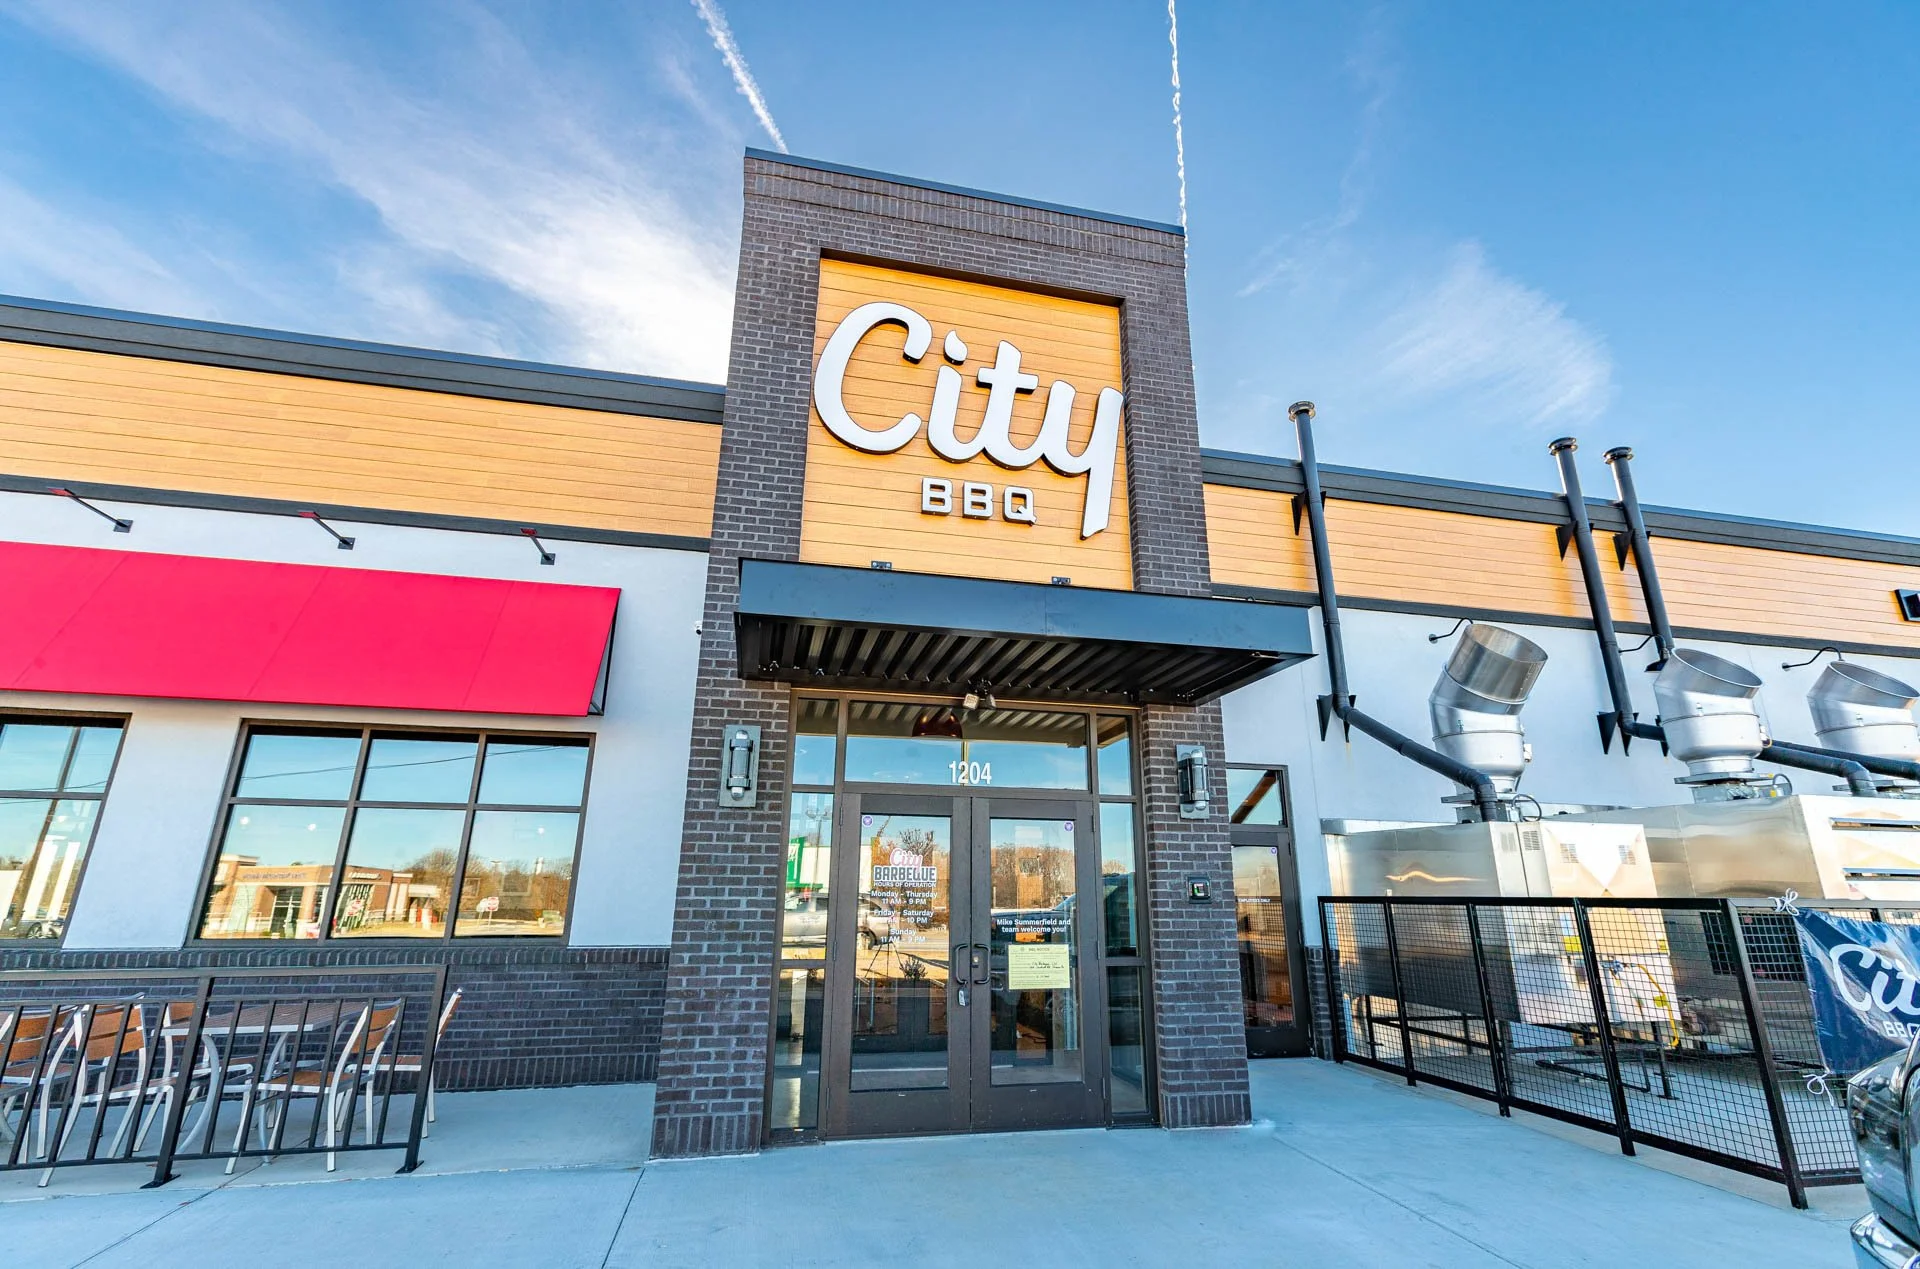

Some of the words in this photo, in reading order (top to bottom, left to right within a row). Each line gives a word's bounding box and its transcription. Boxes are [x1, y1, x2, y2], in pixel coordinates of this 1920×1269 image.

[813, 301, 1125, 541] City
[921, 477, 1037, 526] BBQ
[948, 760, 992, 785] 1204
[890, 847, 924, 874] City
[874, 866, 937, 882] BARBEQUE
[871, 890, 899, 898] Monday
[906, 890, 938, 898] Thursday
[873, 909, 896, 917] Friday
[903, 909, 934, 917] Saturday
[996, 918, 1013, 926] Mike
[1014, 918, 1057, 926] Summerfield
[1058, 918, 1071, 926] and
[890, 928, 916, 936] Sunday
[1020, 925, 1051, 933] welcome
[1051, 926, 1067, 934] you!
